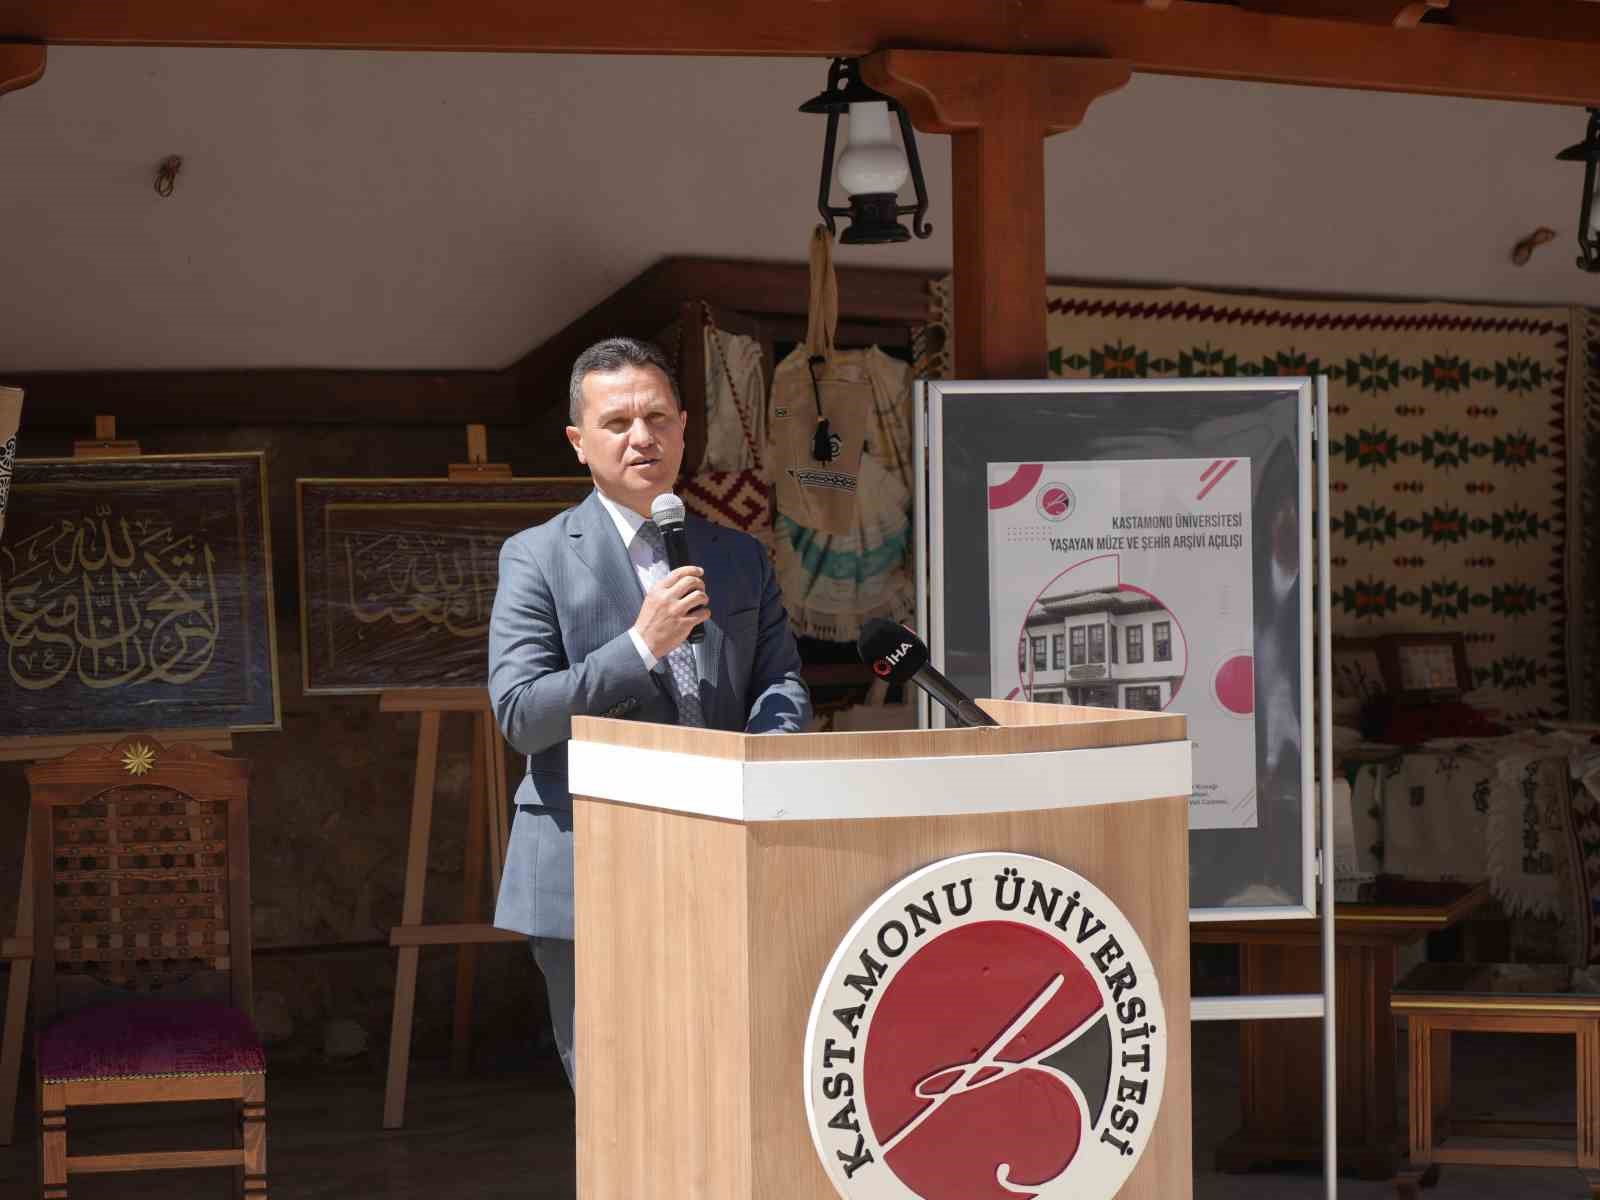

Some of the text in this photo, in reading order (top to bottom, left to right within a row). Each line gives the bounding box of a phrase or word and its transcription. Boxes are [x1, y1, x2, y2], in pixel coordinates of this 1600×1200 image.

[1112, 512, 1242, 529] KASTAMONU ÜNİVERSİTESİ
[1050, 533, 1242, 553] YAŞAYAN MÜZE VE ŞEHİR ARŞİVİ AÇILIŞI
[823, 867, 1156, 1178] KASTAMONU ÜNİVERSİTESİ
